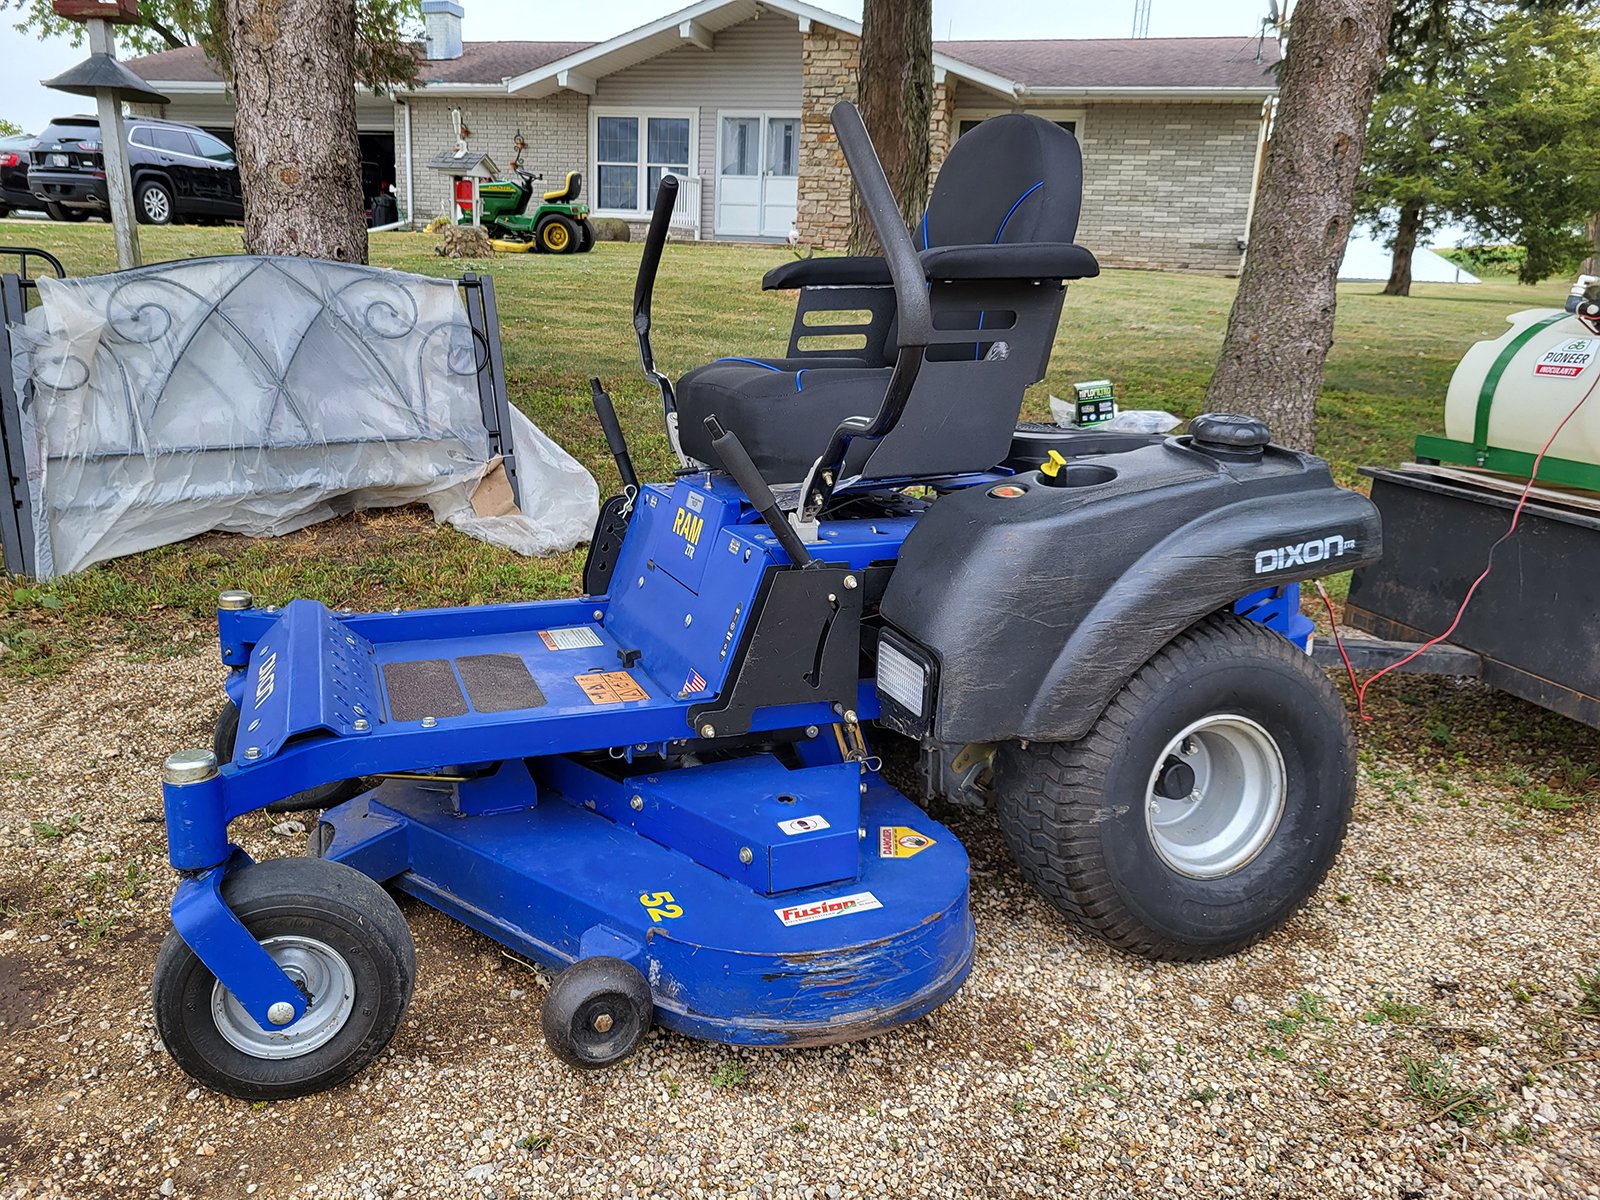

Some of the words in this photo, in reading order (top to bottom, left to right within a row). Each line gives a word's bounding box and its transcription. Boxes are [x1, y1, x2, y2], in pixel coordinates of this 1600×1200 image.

[1543, 352, 1590, 364] PIONEER
[673, 507, 703, 546] RAM
[1255, 535, 1344, 573] DIXON
[883, 829, 892, 855] DANGER
[640, 891, 684, 922] 52
[783, 902, 857, 921] Fusion
